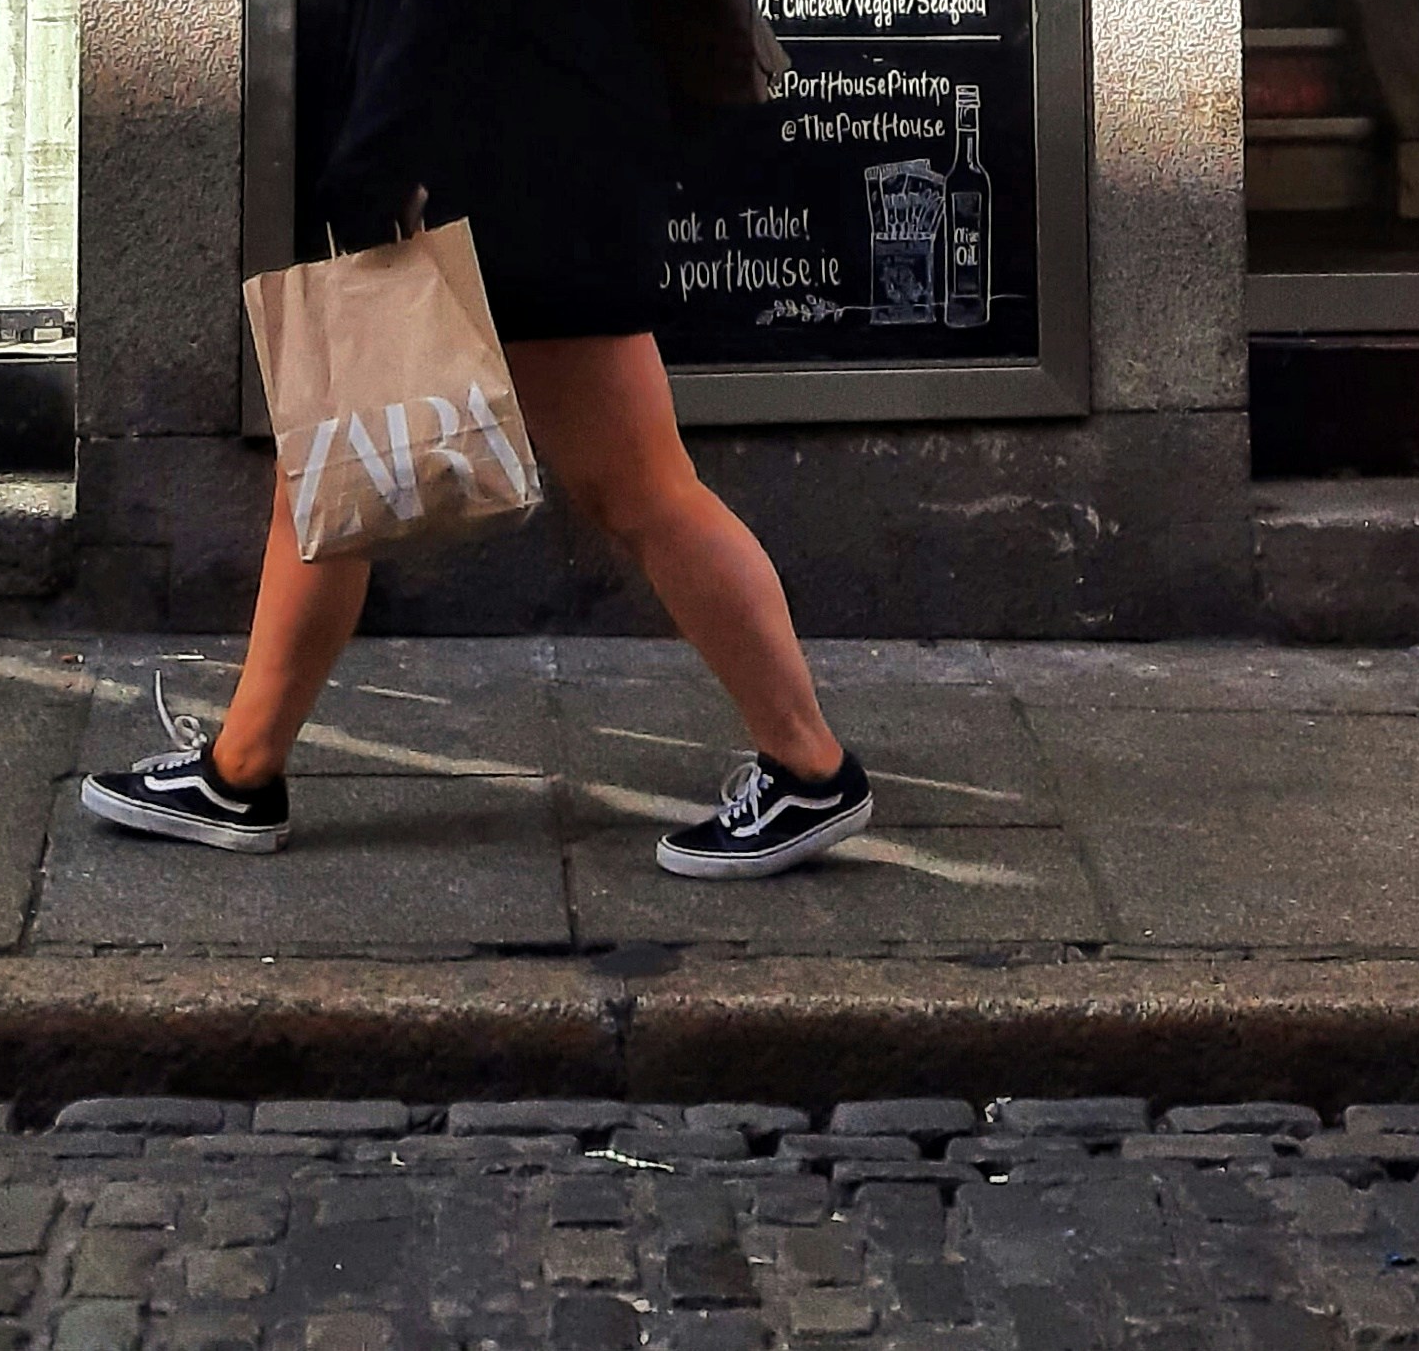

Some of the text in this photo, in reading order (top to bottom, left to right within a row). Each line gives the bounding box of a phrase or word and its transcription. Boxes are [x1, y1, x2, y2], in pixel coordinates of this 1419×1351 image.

[781, 113, 946, 144] @ThePortHouse
[667, 206, 811, 244] ook a Table!
[680, 249, 842, 302] porthouse.ie
